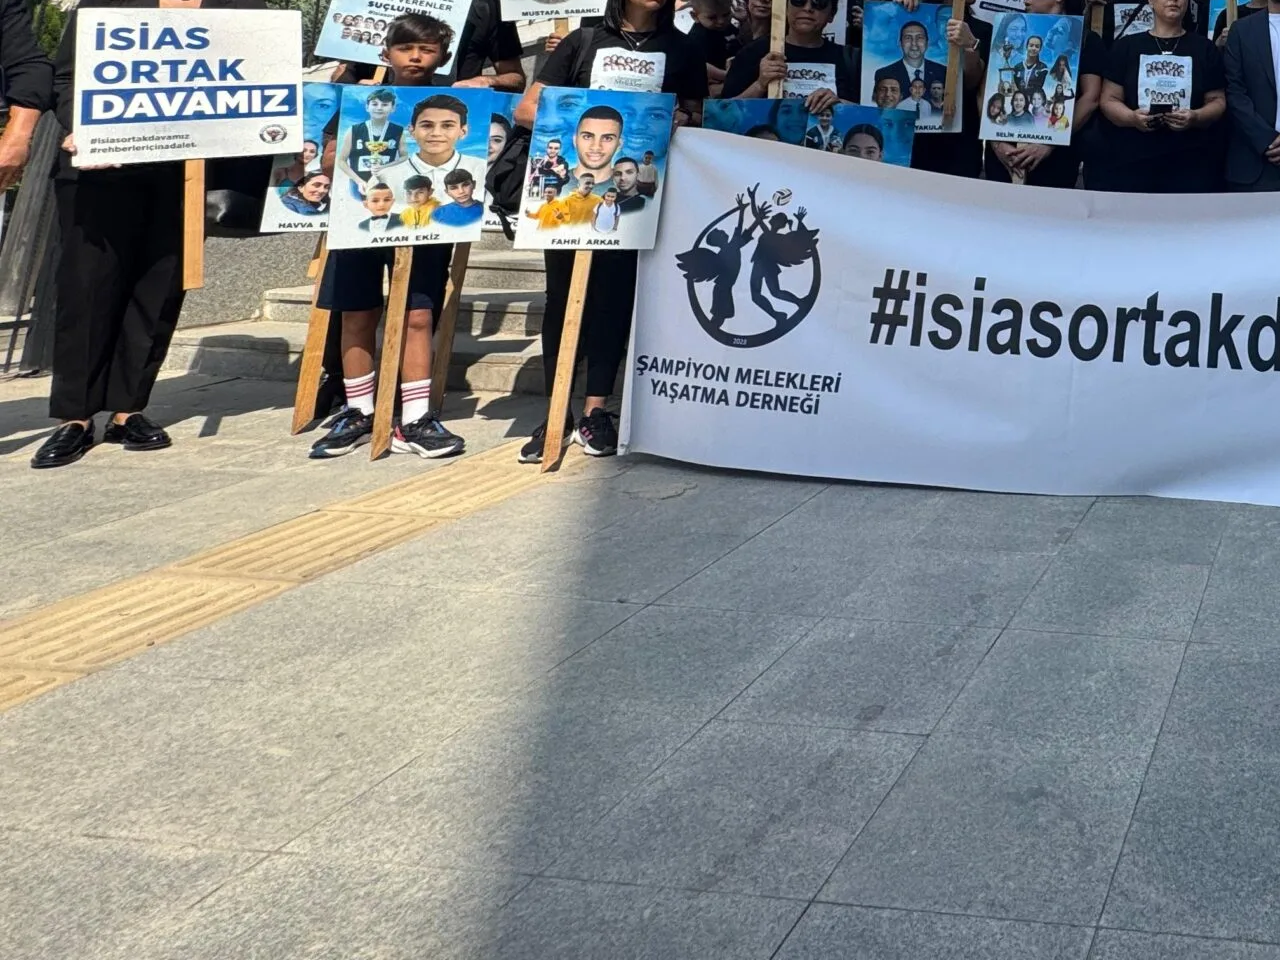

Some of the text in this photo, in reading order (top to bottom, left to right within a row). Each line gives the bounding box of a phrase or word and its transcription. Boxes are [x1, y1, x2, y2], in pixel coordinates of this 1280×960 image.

[521, 9, 560, 17] MUSTAFA
[95, 22, 210, 51] İSİAS
[93, 59, 246, 84] ORTAK
[92, 88, 289, 120] DAVAMIZ
[278, 221, 313, 229] HAVVA
[371, 233, 440, 244] AYKAN EKİZ
[551, 238, 581, 246] FAHRİ
[636, 354, 842, 394] ŞAMPİYON MELEKLERİ
[651, 378, 822, 415] YAŞATMA DERNEĞİ
